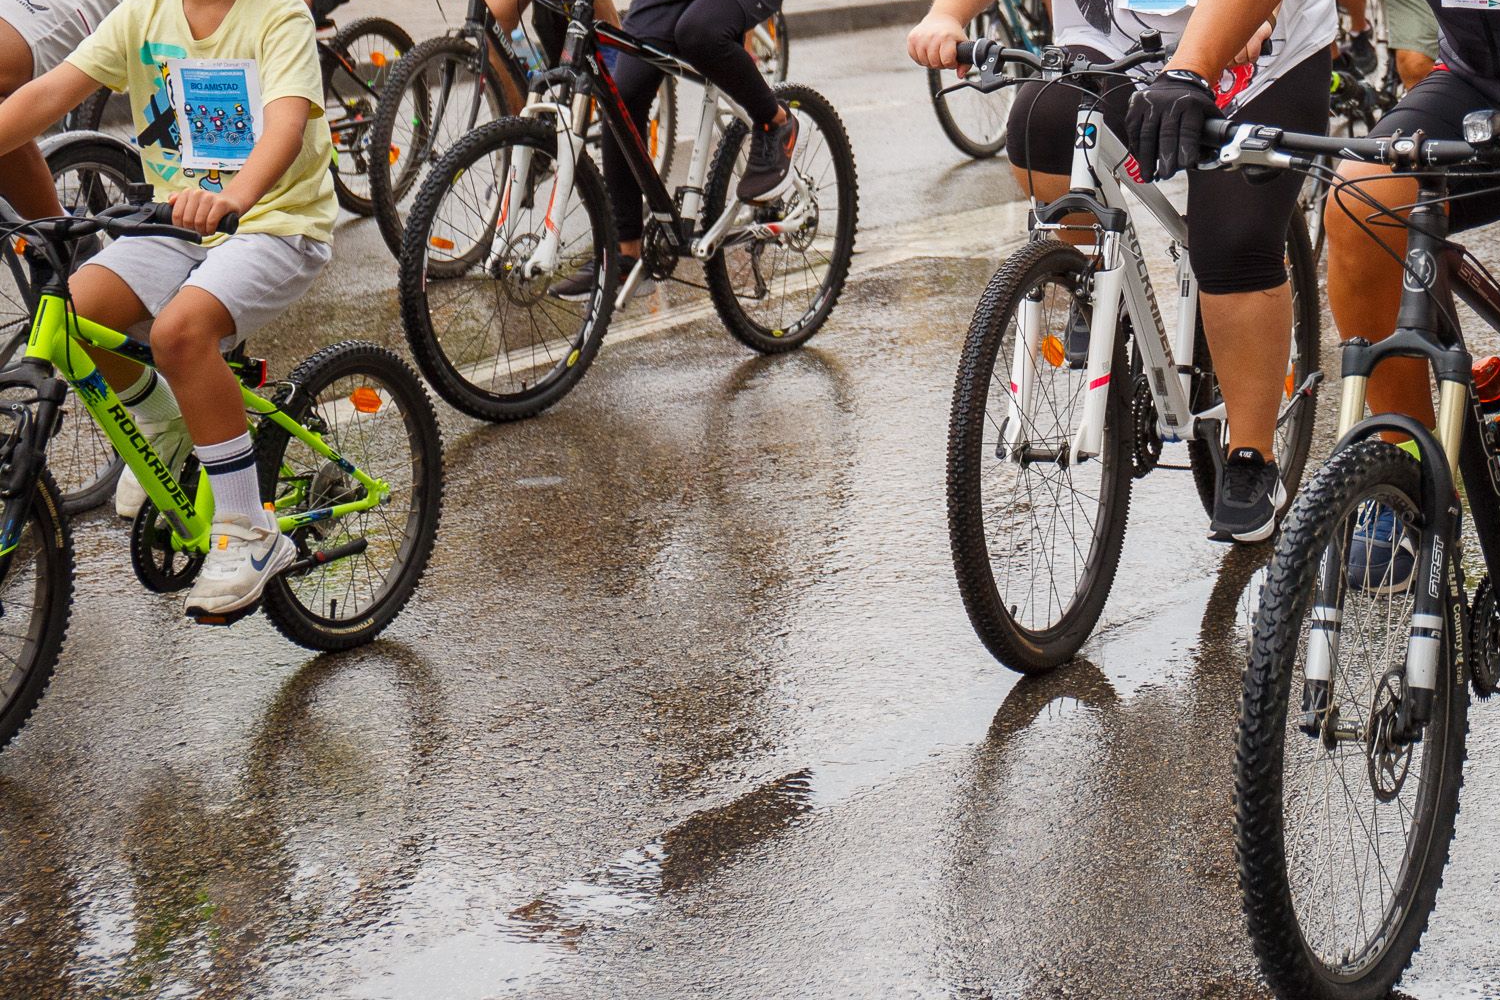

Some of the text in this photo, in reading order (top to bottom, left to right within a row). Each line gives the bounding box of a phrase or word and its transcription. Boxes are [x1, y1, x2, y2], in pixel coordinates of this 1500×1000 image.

[190, 82, 239, 91] BICI AMISTAD
[1125, 220, 1176, 369] ROCKRIDER
[107, 402, 196, 519] ROCKRIDER
[1452, 603, 1465, 651] Country
[1455, 665, 1465, 685] trail
